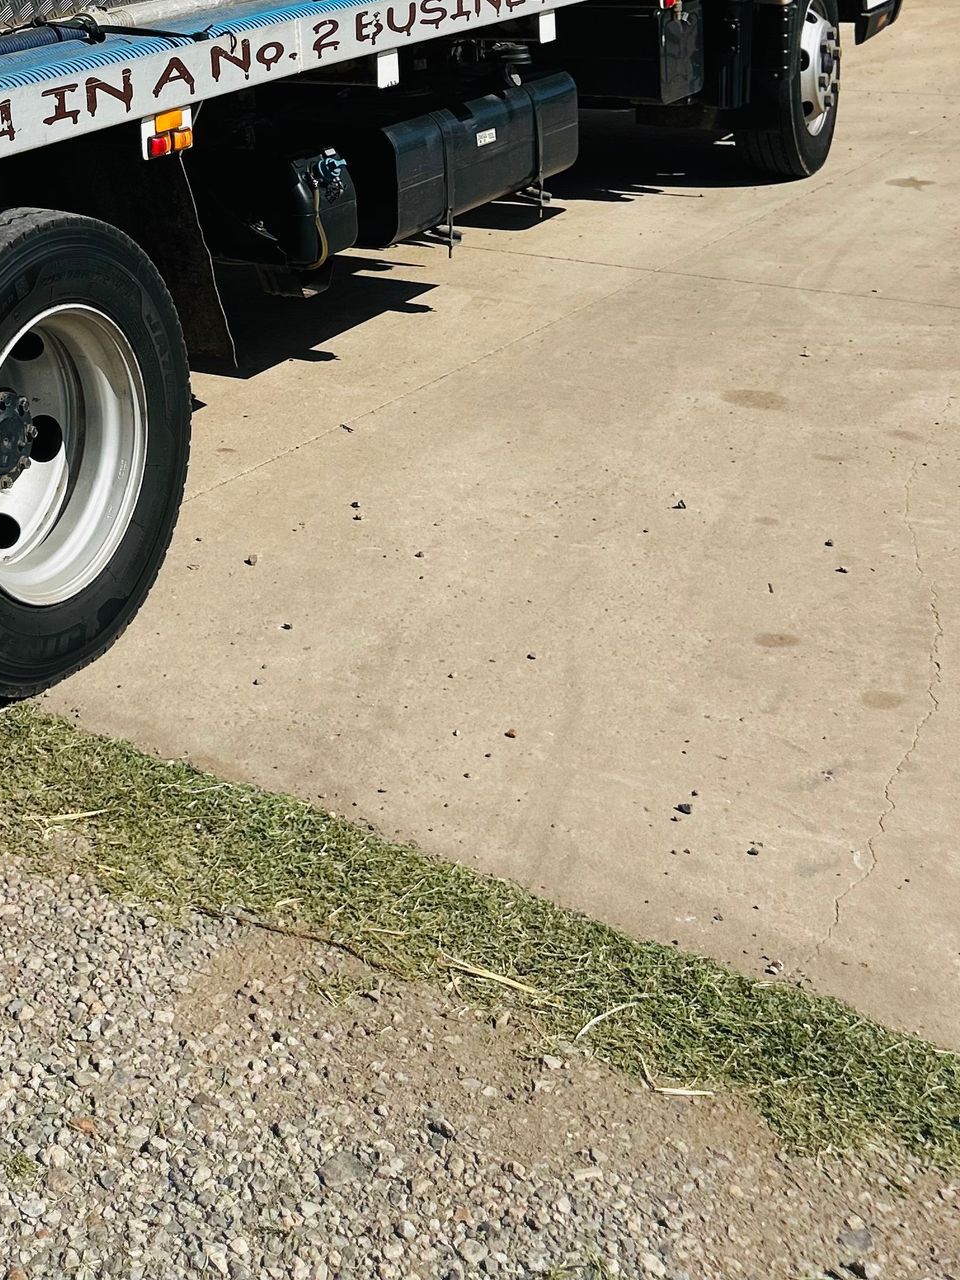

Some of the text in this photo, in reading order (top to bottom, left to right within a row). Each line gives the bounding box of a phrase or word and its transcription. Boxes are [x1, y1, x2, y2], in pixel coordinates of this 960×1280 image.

[42, 68, 133, 124] IN
[152, 57, 195, 98] A
[210, 38, 298, 81] No.
[313, 19, 340, 59] 2
